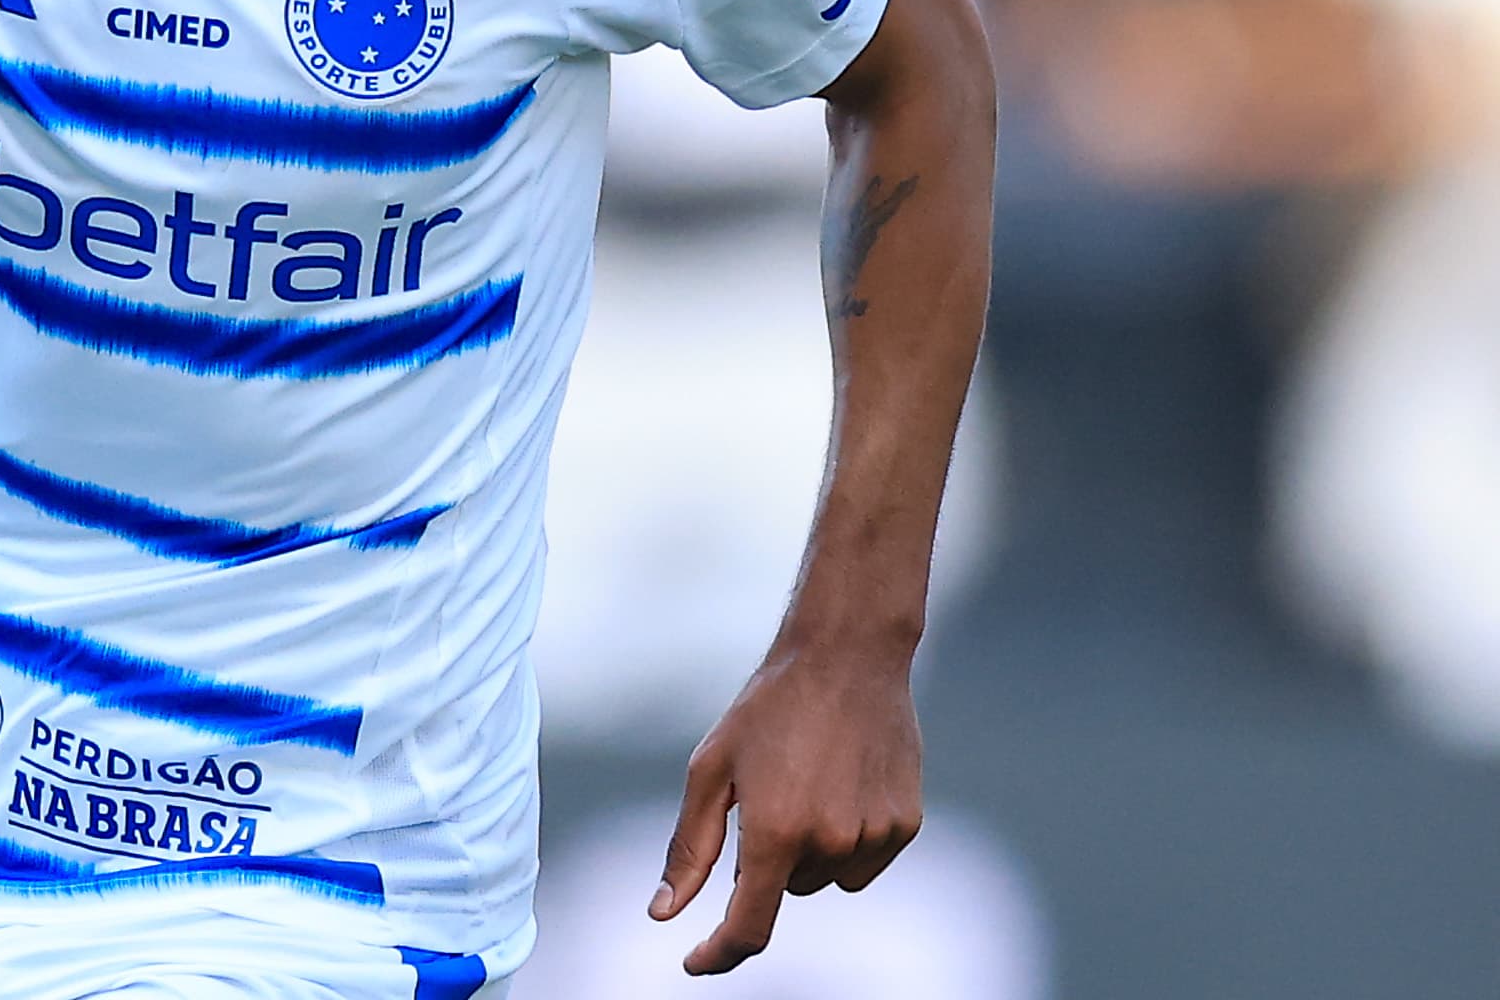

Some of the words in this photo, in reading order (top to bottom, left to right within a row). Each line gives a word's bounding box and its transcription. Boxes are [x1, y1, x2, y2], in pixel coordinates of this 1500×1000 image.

[106, 6, 230, 49] CIMED
[293, 0, 379, 92] ESPORTE
[392, 6, 447, 85] CLUBE
